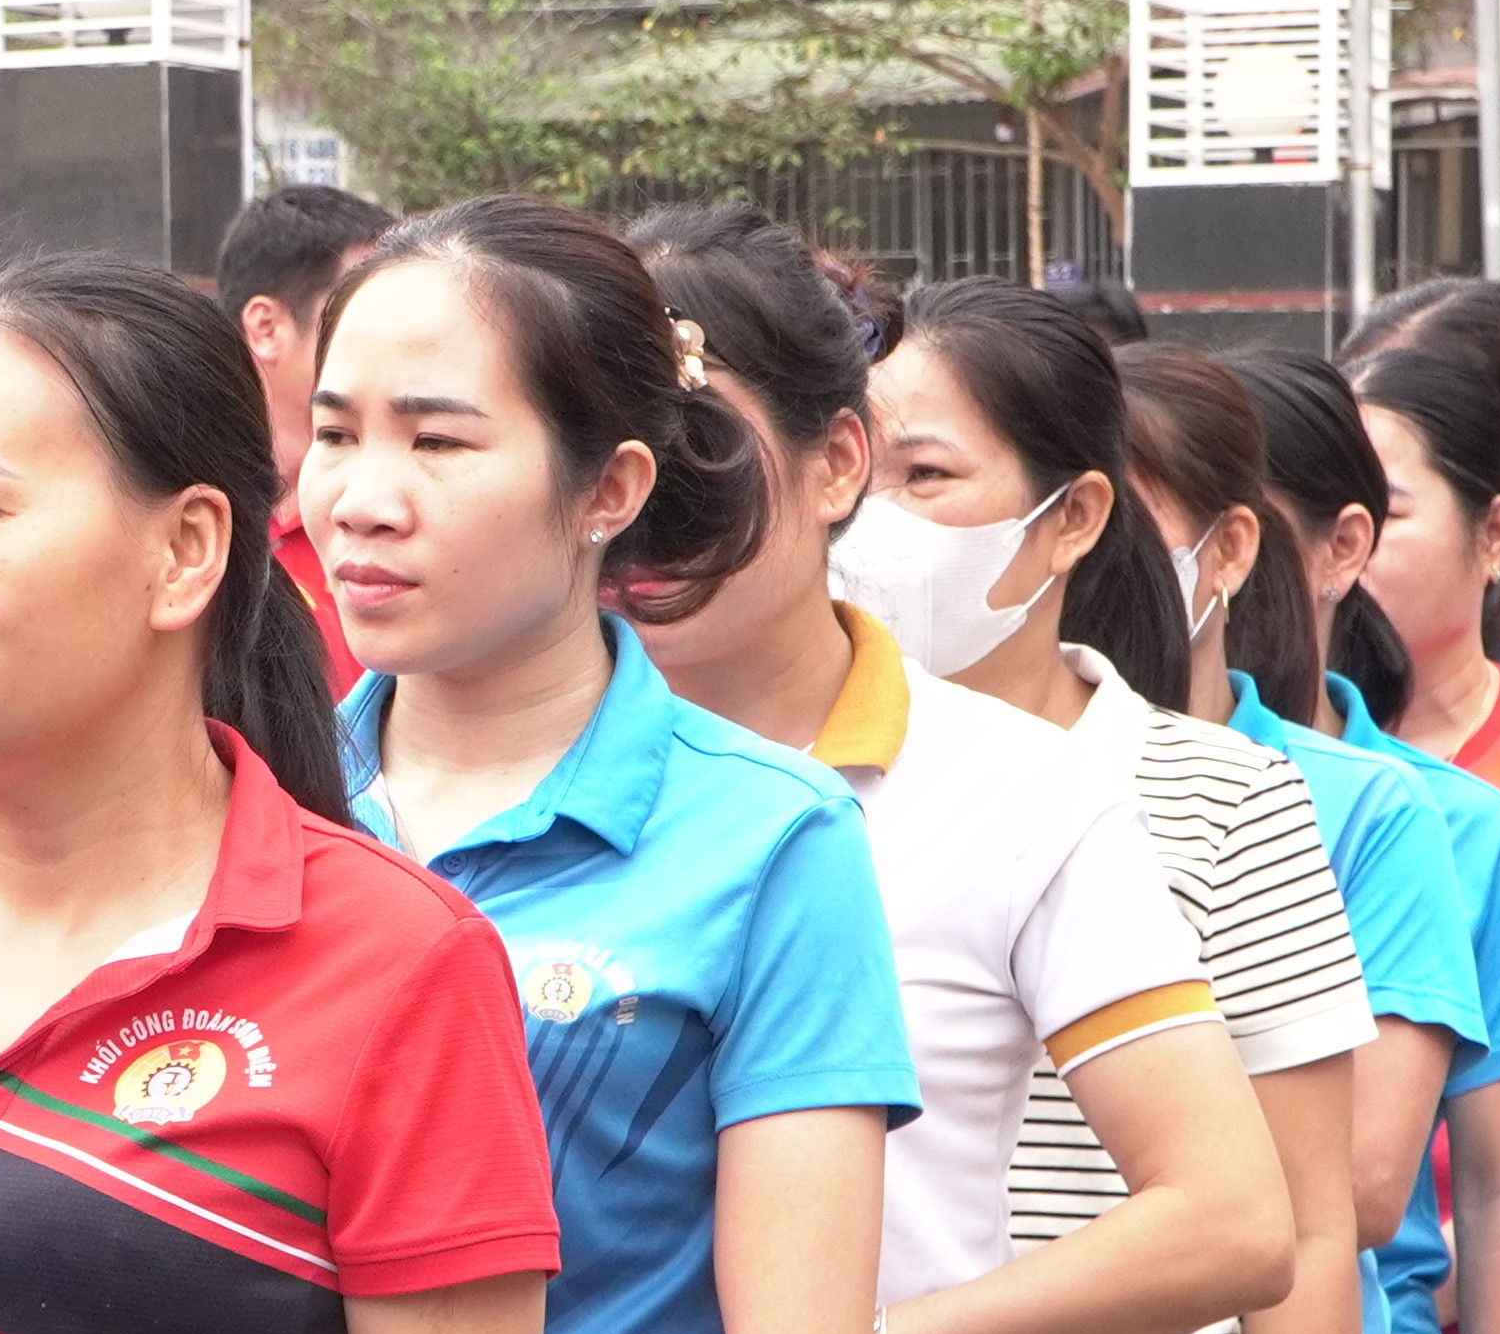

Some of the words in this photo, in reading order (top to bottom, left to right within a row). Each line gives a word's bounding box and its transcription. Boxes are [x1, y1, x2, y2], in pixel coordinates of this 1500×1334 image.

[79, 1039, 124, 1086] KHỐI
[119, 1009, 176, 1049] CÔNG
[180, 1007, 238, 1032] ĐOÀN
[243, 1045, 278, 1089] ĐIỆN
